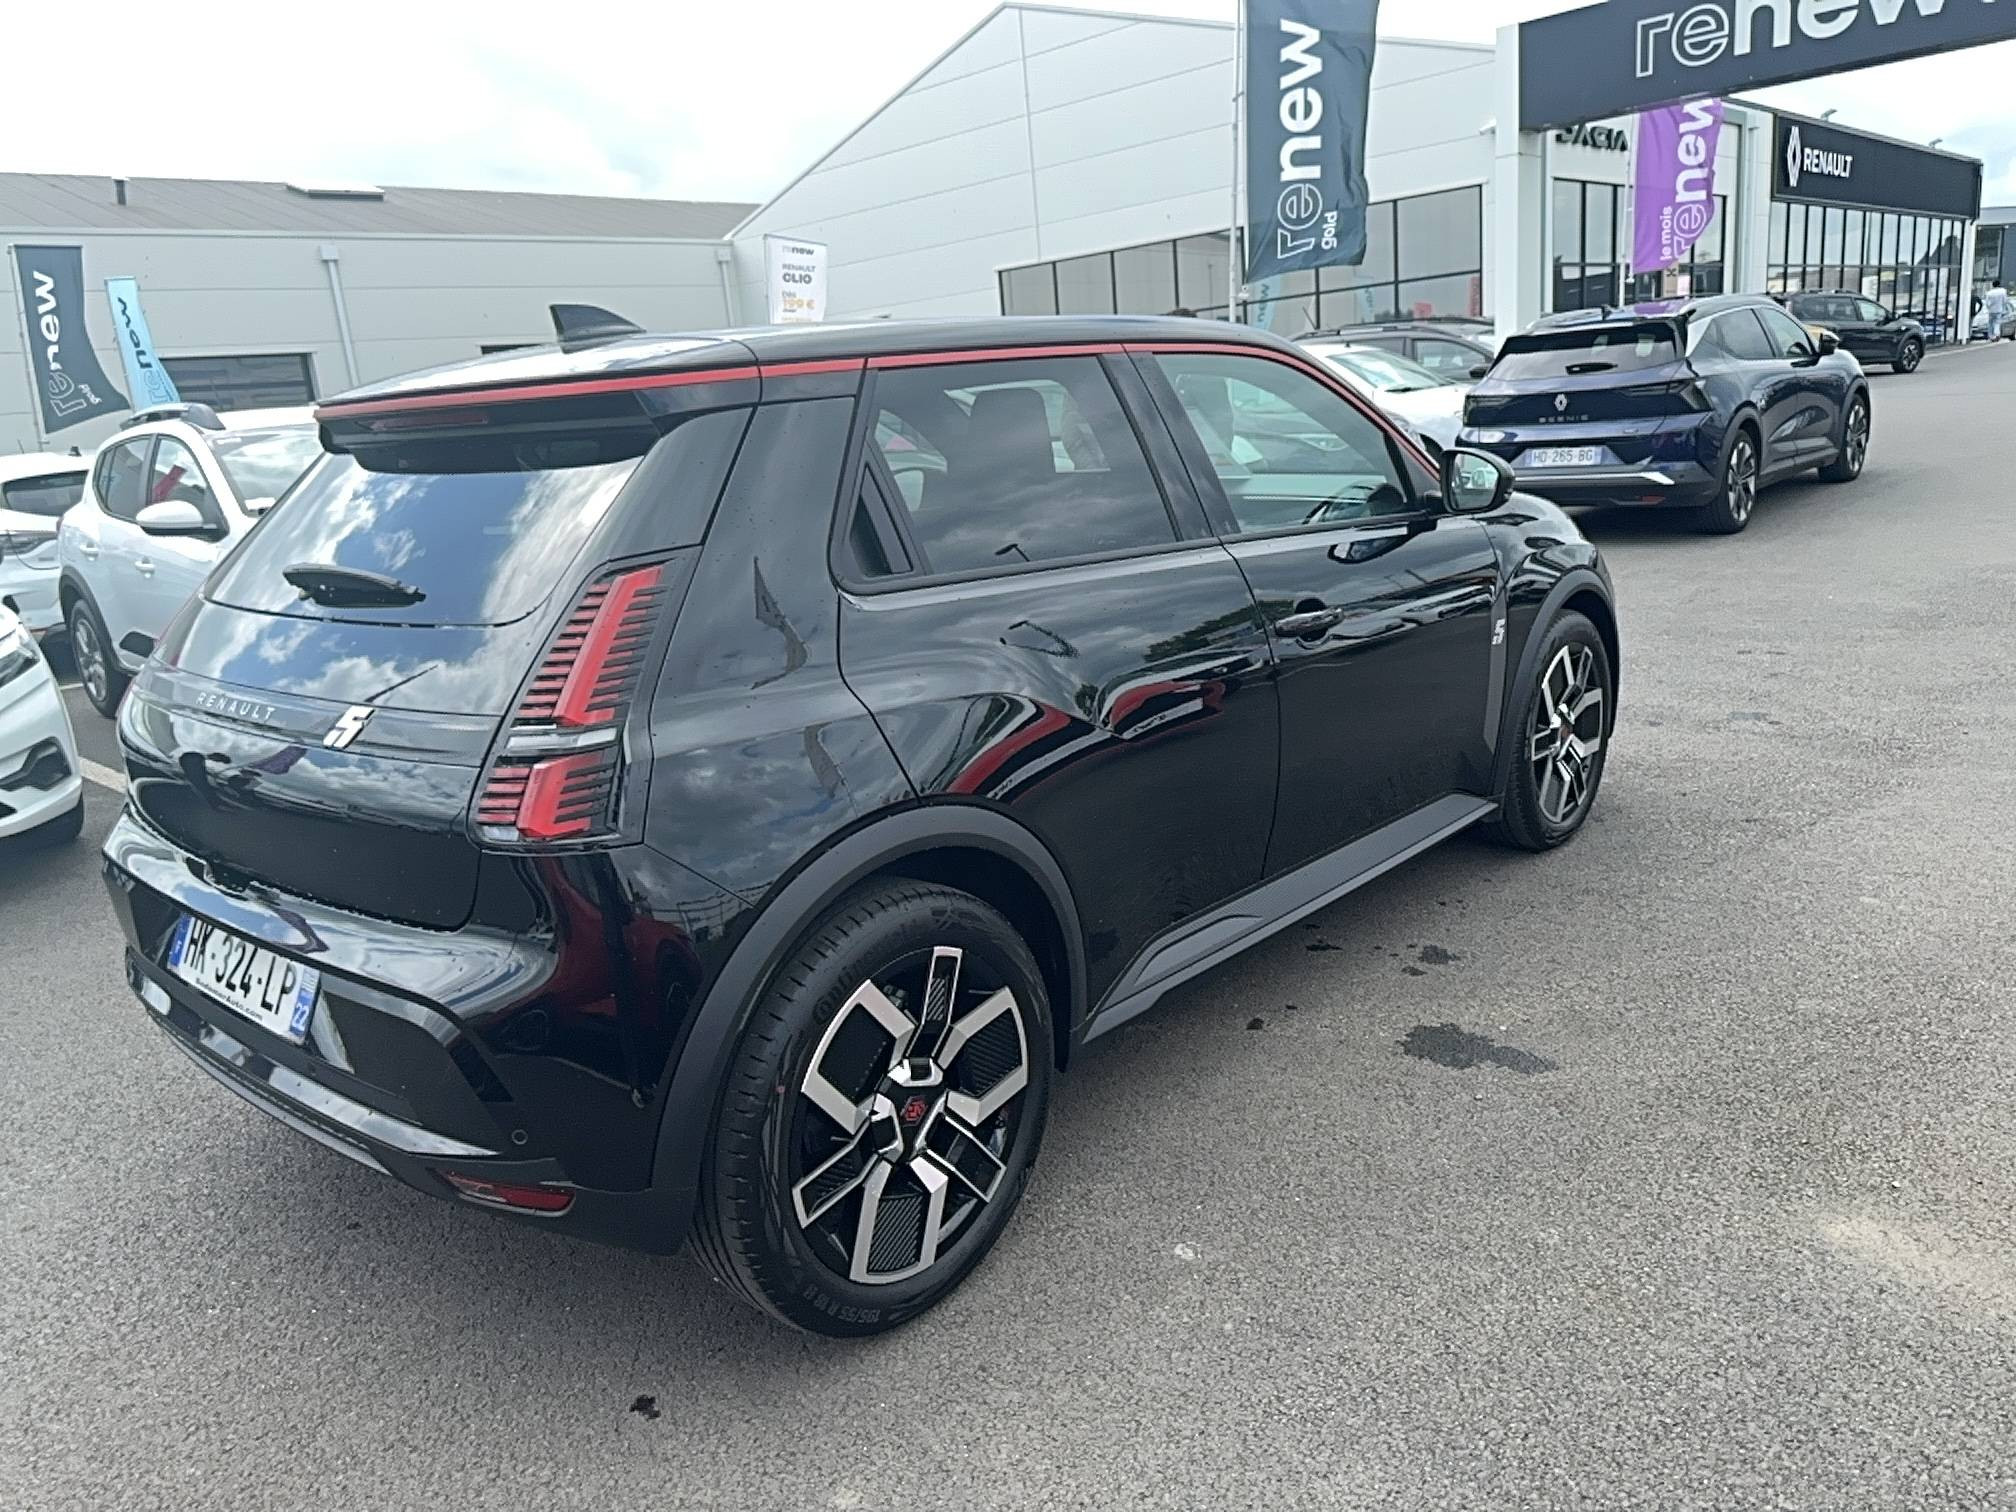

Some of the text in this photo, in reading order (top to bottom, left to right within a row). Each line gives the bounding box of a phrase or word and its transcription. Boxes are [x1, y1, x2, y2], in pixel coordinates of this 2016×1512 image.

[1277, 18, 1323, 259] renew
[1803, 147, 1853, 178] RENAULT
[1321, 210, 1338, 250] gold
[1660, 206, 1672, 260] le mois
[782, 272, 812, 285] CLIO
[195, 692, 278, 721] RENAULT
[292, 1001, 310, 1032] 22
